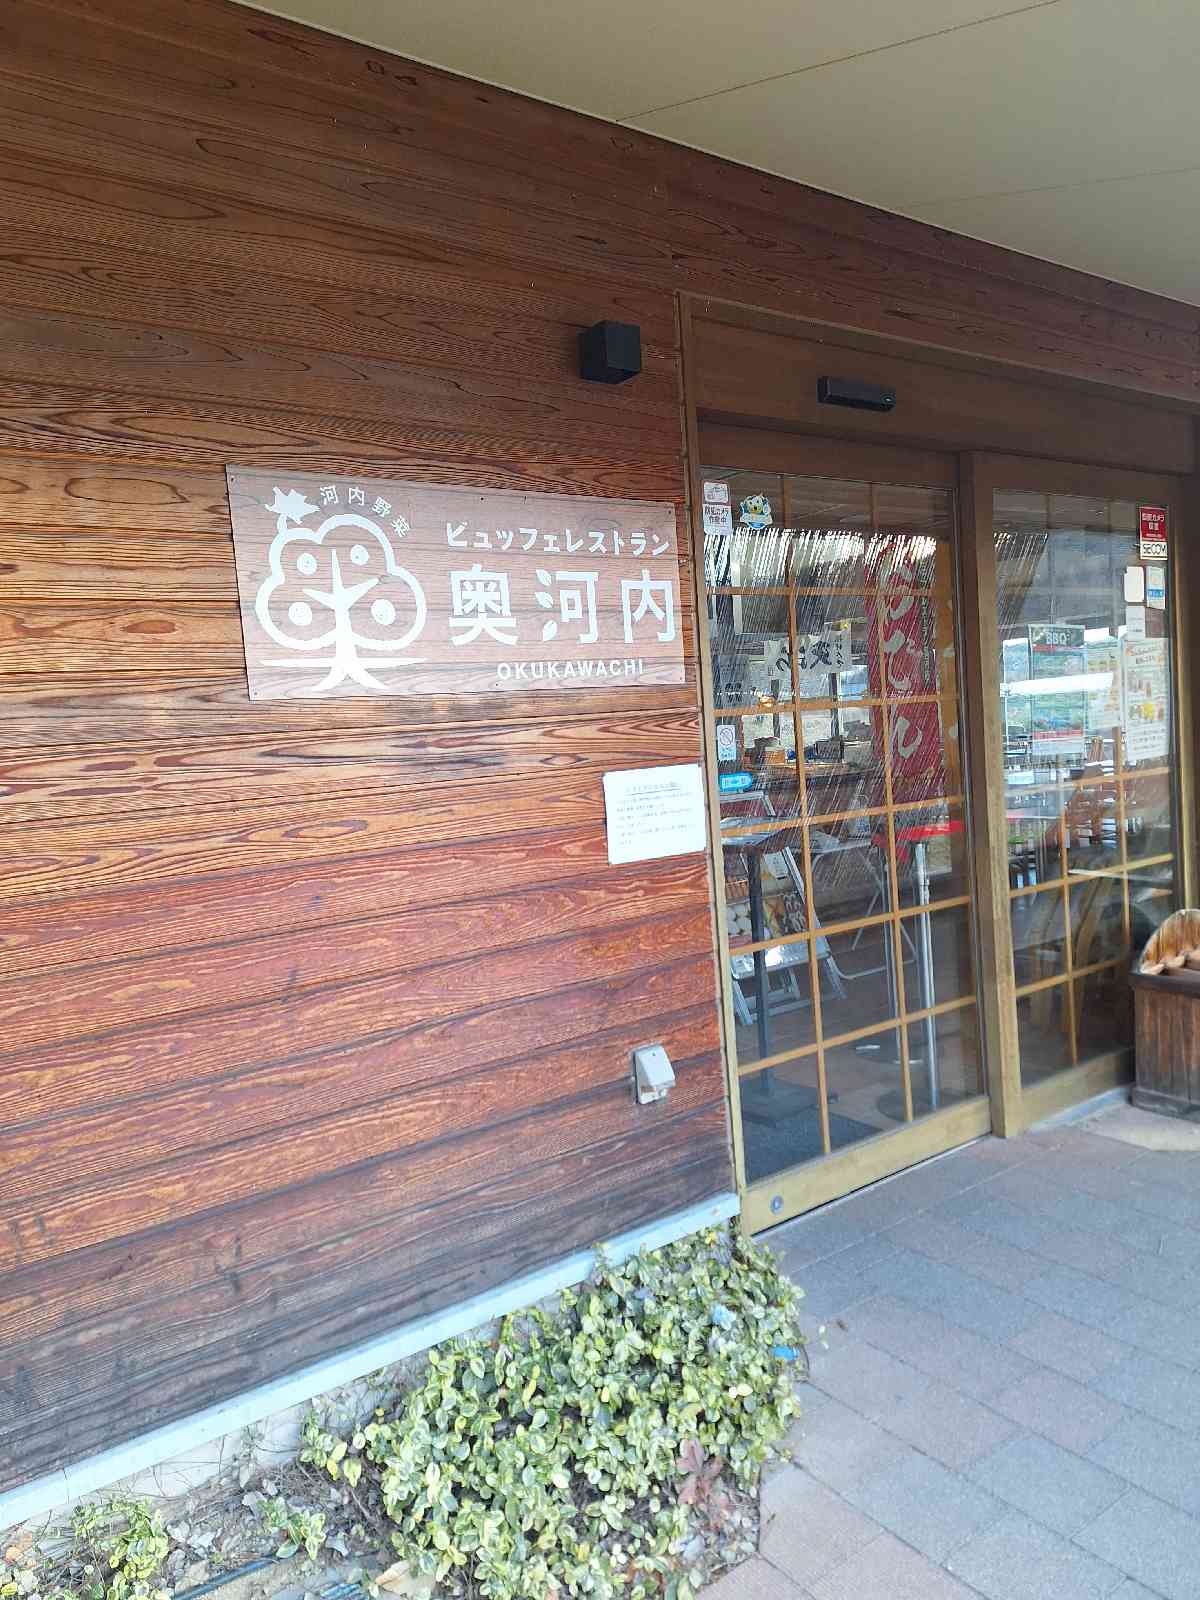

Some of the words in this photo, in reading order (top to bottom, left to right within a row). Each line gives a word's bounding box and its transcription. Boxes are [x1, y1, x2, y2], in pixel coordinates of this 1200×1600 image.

[319, 485, 411, 538] 河内野菜
[446, 521, 670, 556] ビュッフェレストラン
[1142, 543, 1167, 555] SECOM
[449, 563, 676, 645] 奥河内
[496, 658, 645, 681] OKUKAWACHI
